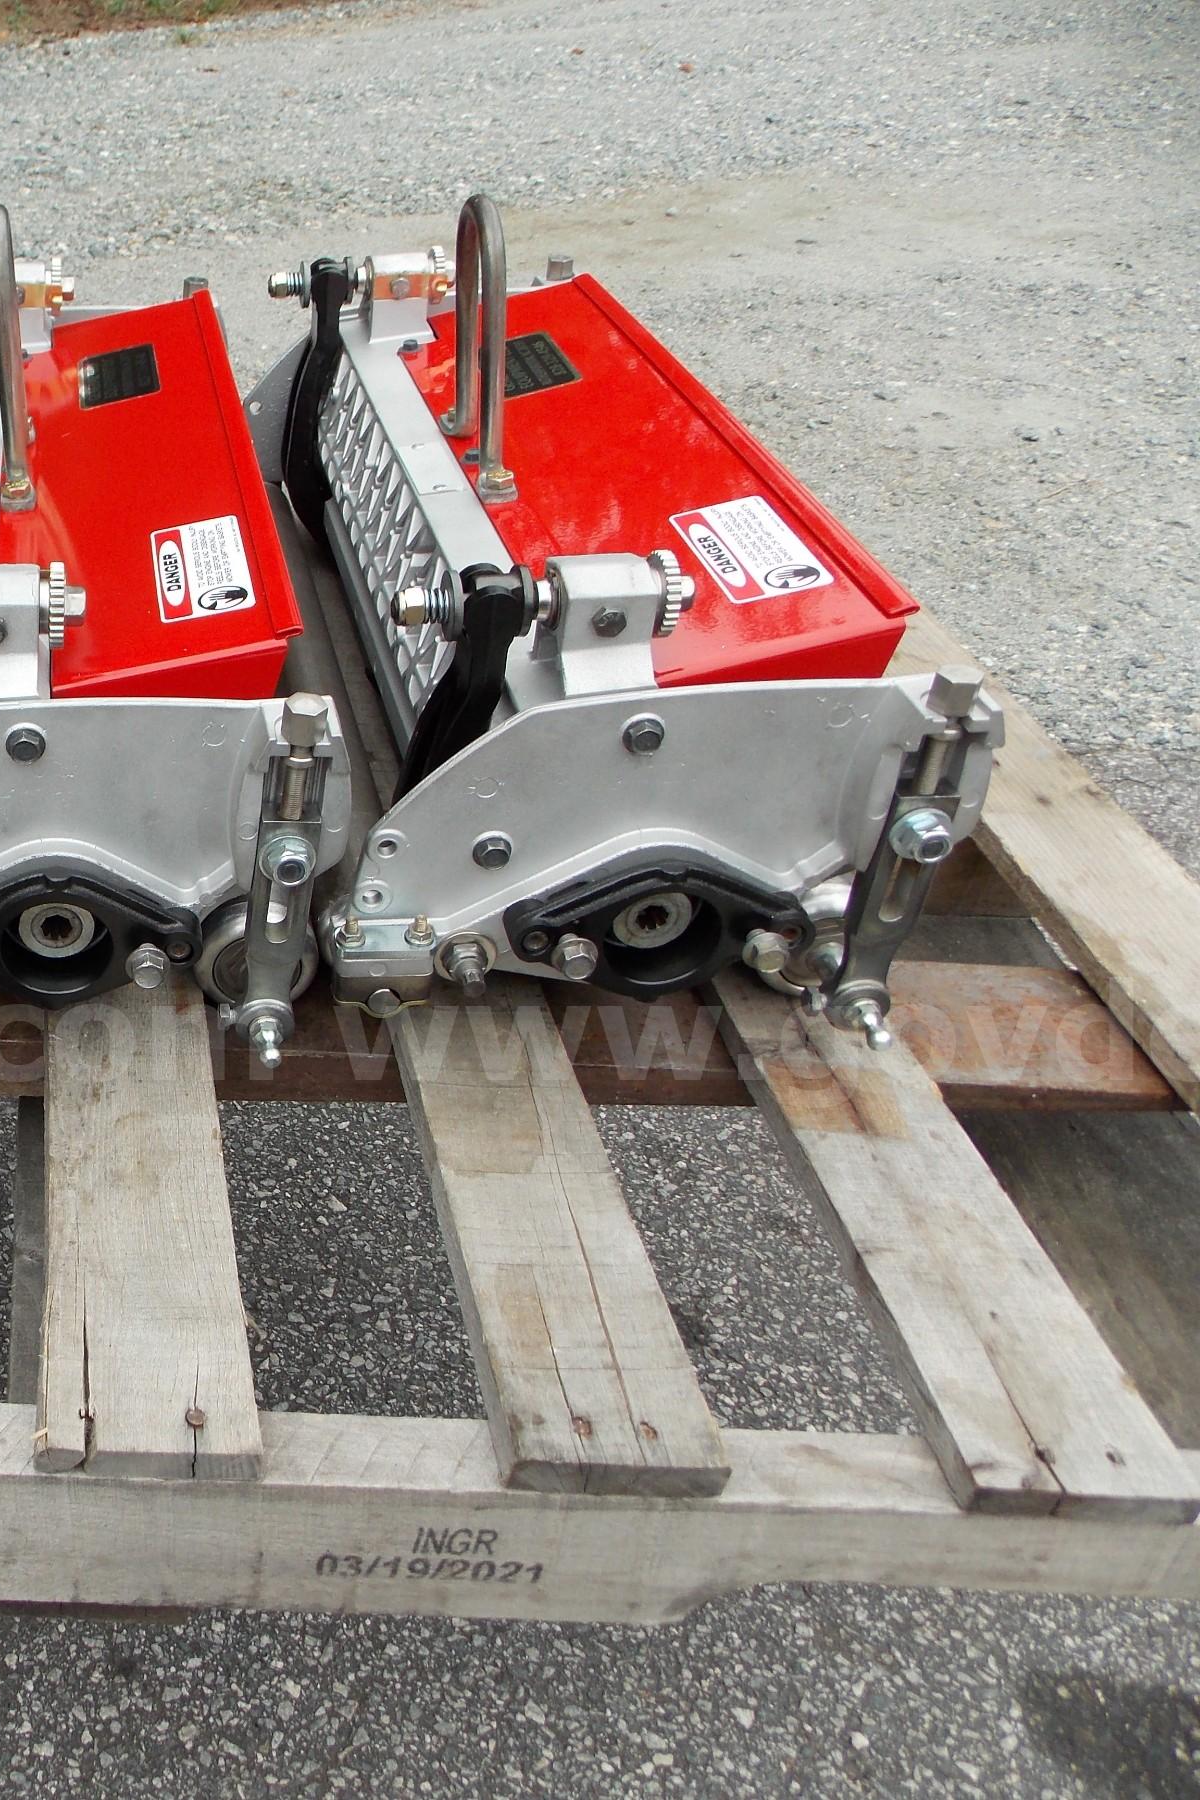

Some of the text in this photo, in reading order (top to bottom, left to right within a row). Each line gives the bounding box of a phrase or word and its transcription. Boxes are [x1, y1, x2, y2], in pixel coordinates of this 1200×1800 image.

[163, 552, 181, 592] DANGER
[697, 535, 738, 574] DANGER
[412, 1527, 498, 1556] INGR
[316, 1552, 544, 1584] 03/19/2021
